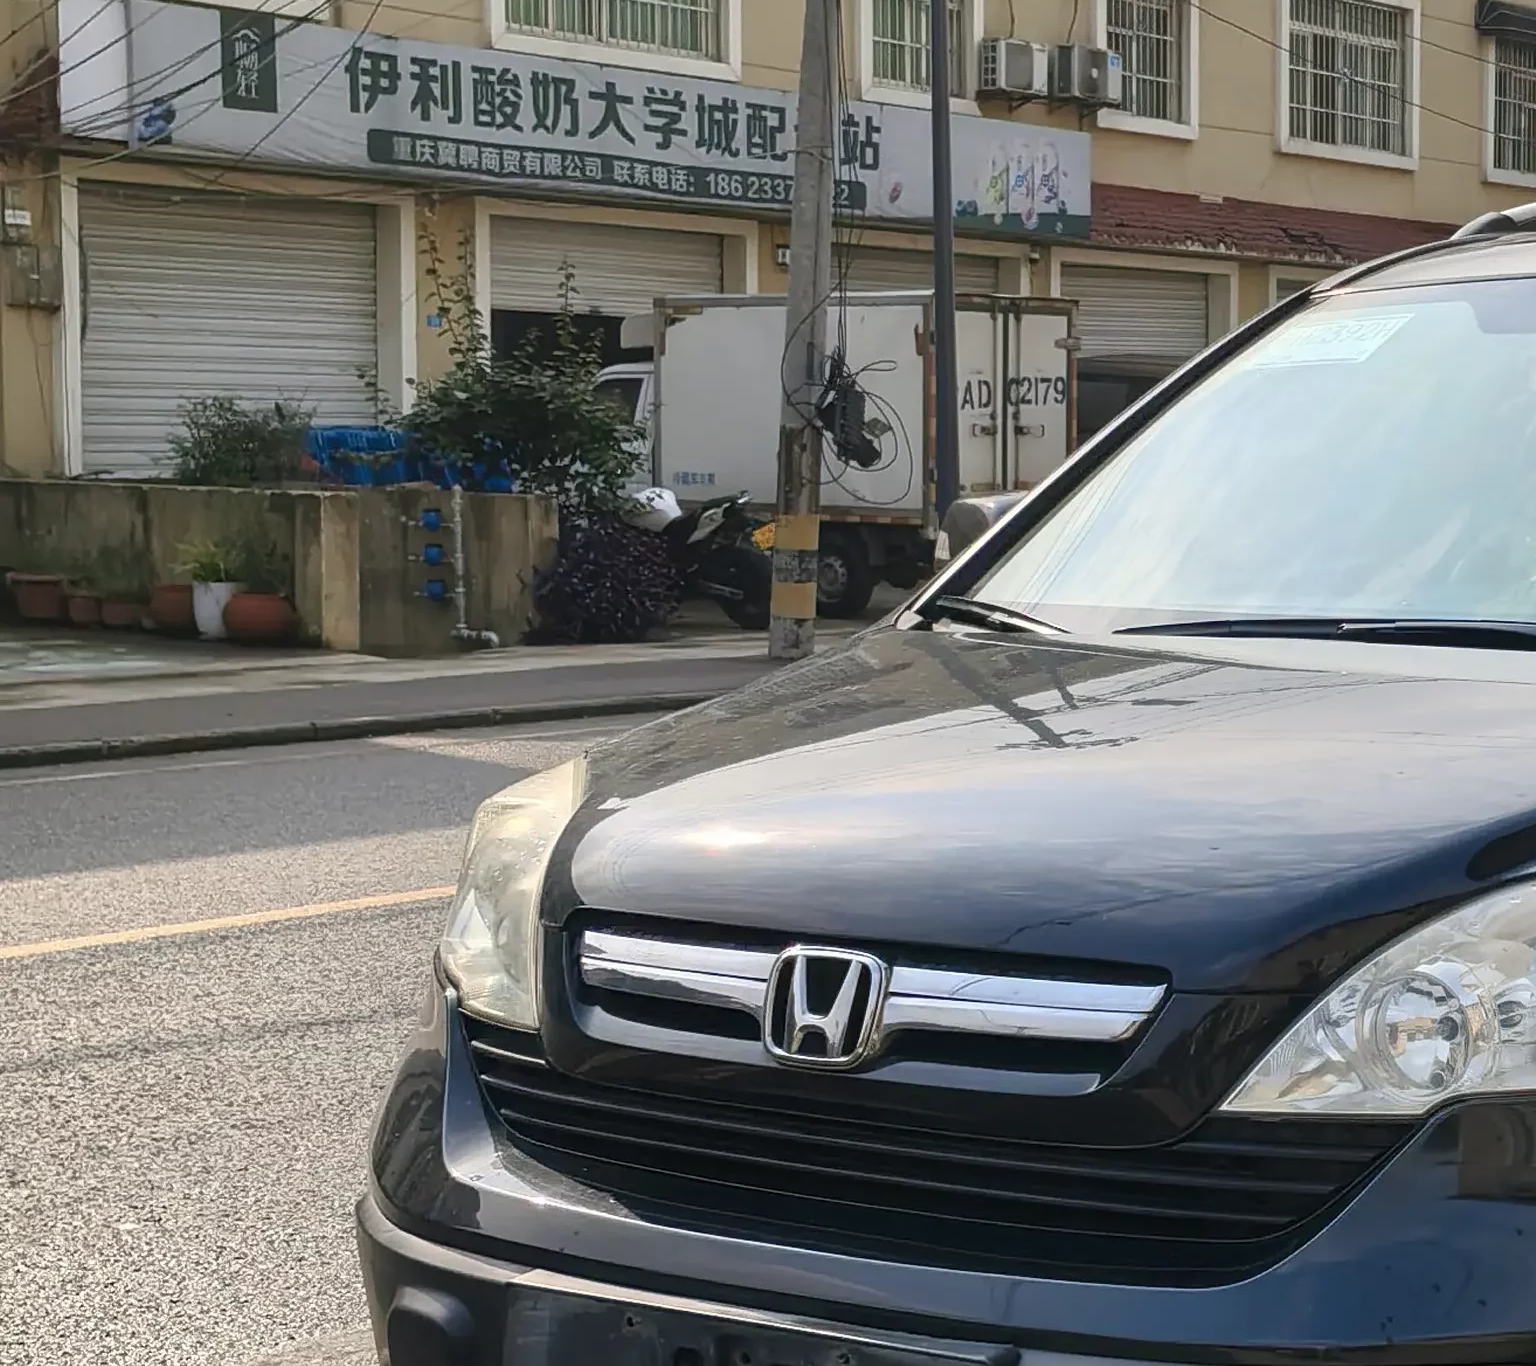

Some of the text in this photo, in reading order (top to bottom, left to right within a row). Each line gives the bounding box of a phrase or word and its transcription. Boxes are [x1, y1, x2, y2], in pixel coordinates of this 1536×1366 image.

[344, 46, 882, 171] 伊利酸奶大学城配站
[705, 172, 743, 197] 186
[960, 379, 993, 410] AD
